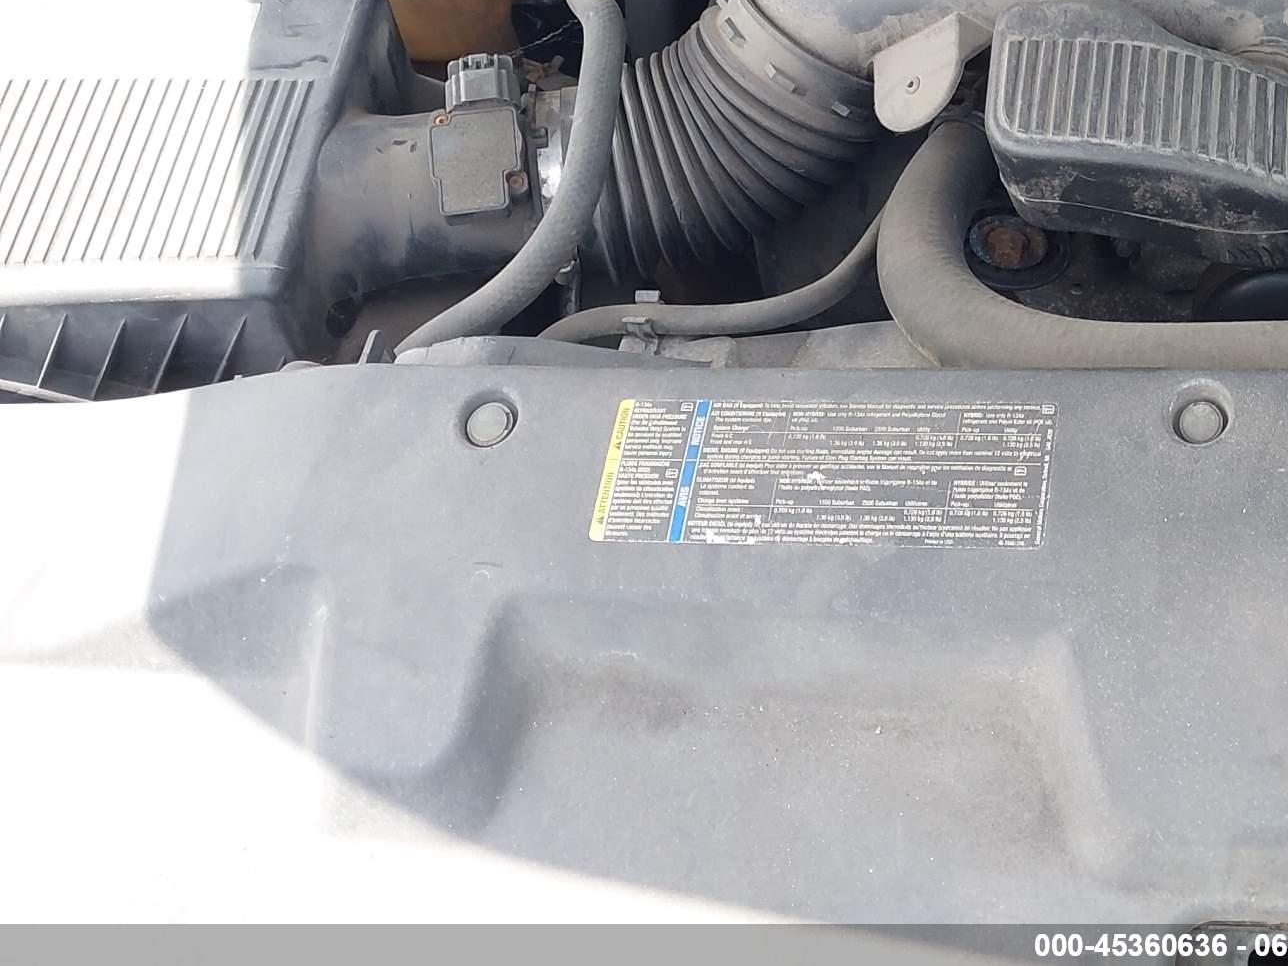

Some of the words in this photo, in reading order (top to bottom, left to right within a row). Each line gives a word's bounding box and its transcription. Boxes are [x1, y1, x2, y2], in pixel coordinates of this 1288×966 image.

[616, 407, 631, 437] CAUTION
[691, 416, 705, 446] NOTICE
[598, 472, 614, 514] ATTENTION
[677, 486, 690, 507] AVIS
